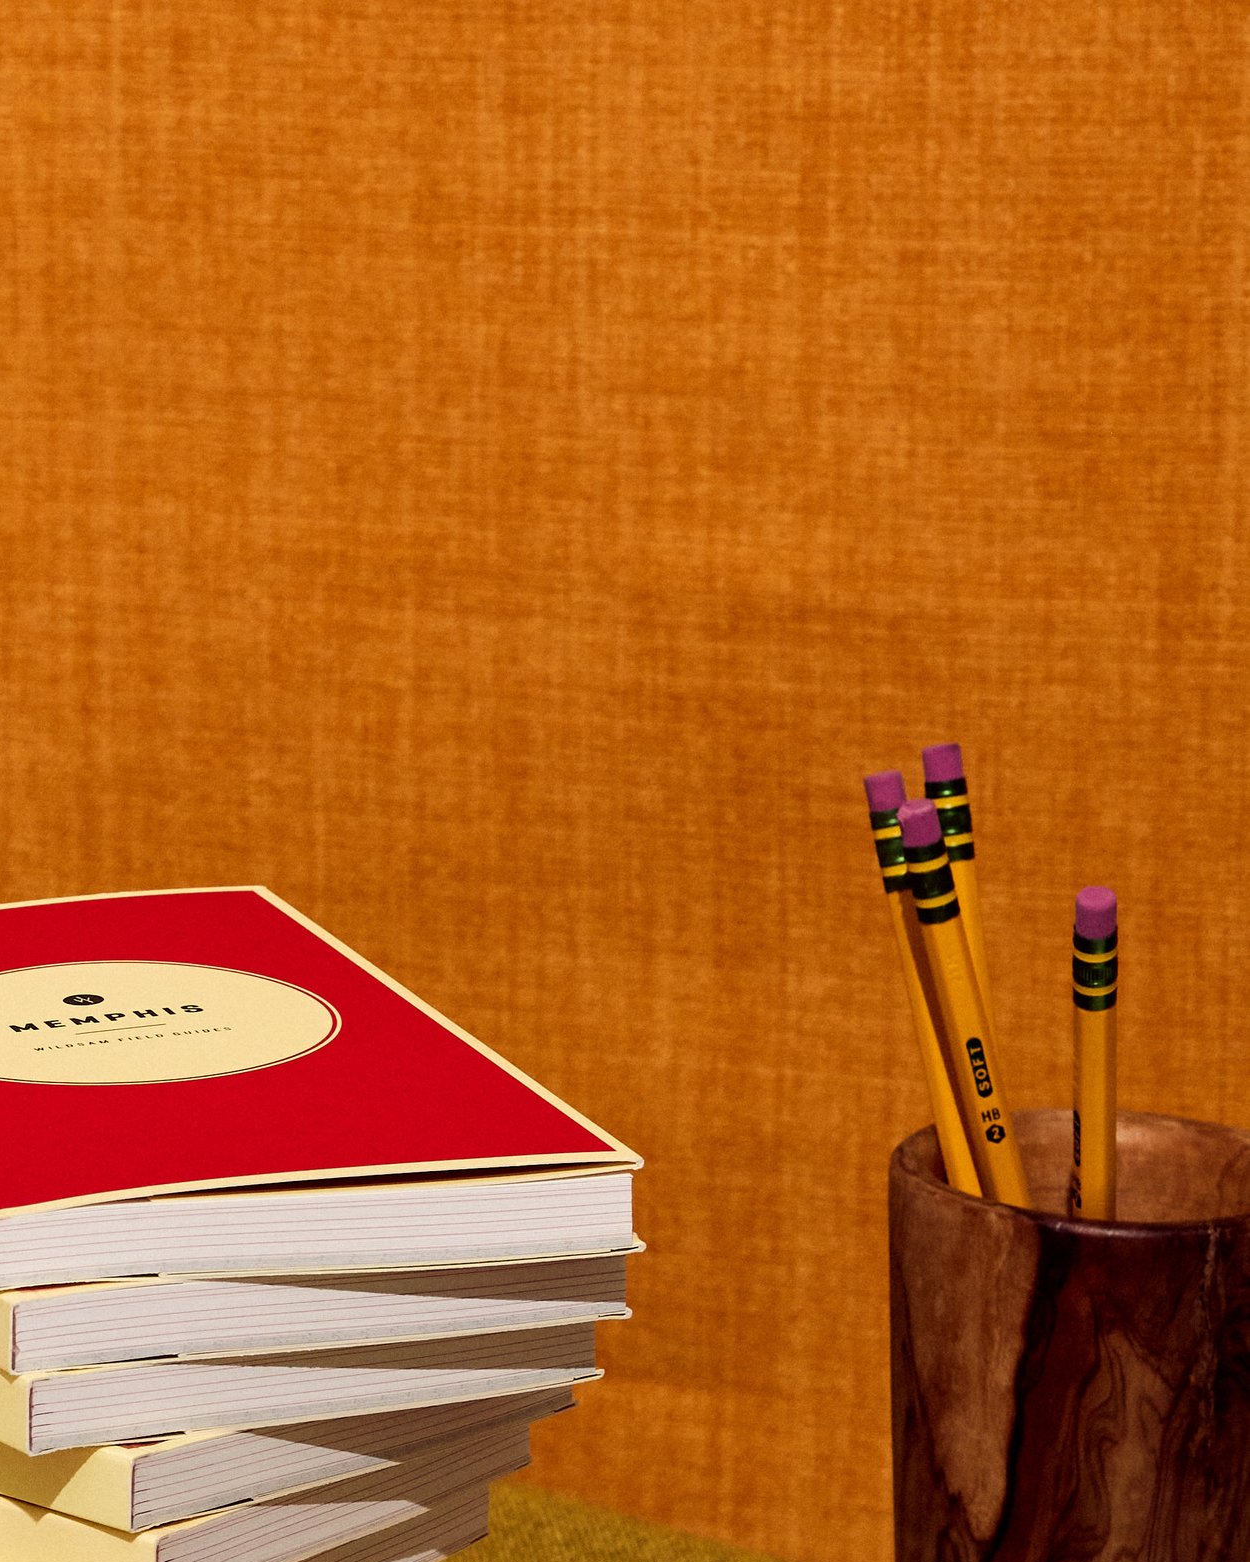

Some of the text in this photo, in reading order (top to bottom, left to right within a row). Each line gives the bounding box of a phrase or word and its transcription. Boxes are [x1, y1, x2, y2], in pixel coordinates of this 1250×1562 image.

[8, 1004, 205, 1034] MEMPHIS
[33, 1025, 233, 1053] WILDSAM FIELD GUIDES
[970, 1046, 991, 1093] SOFT
[980, 1106, 1002, 1124] HB
[991, 1127, 1001, 1140] 2
